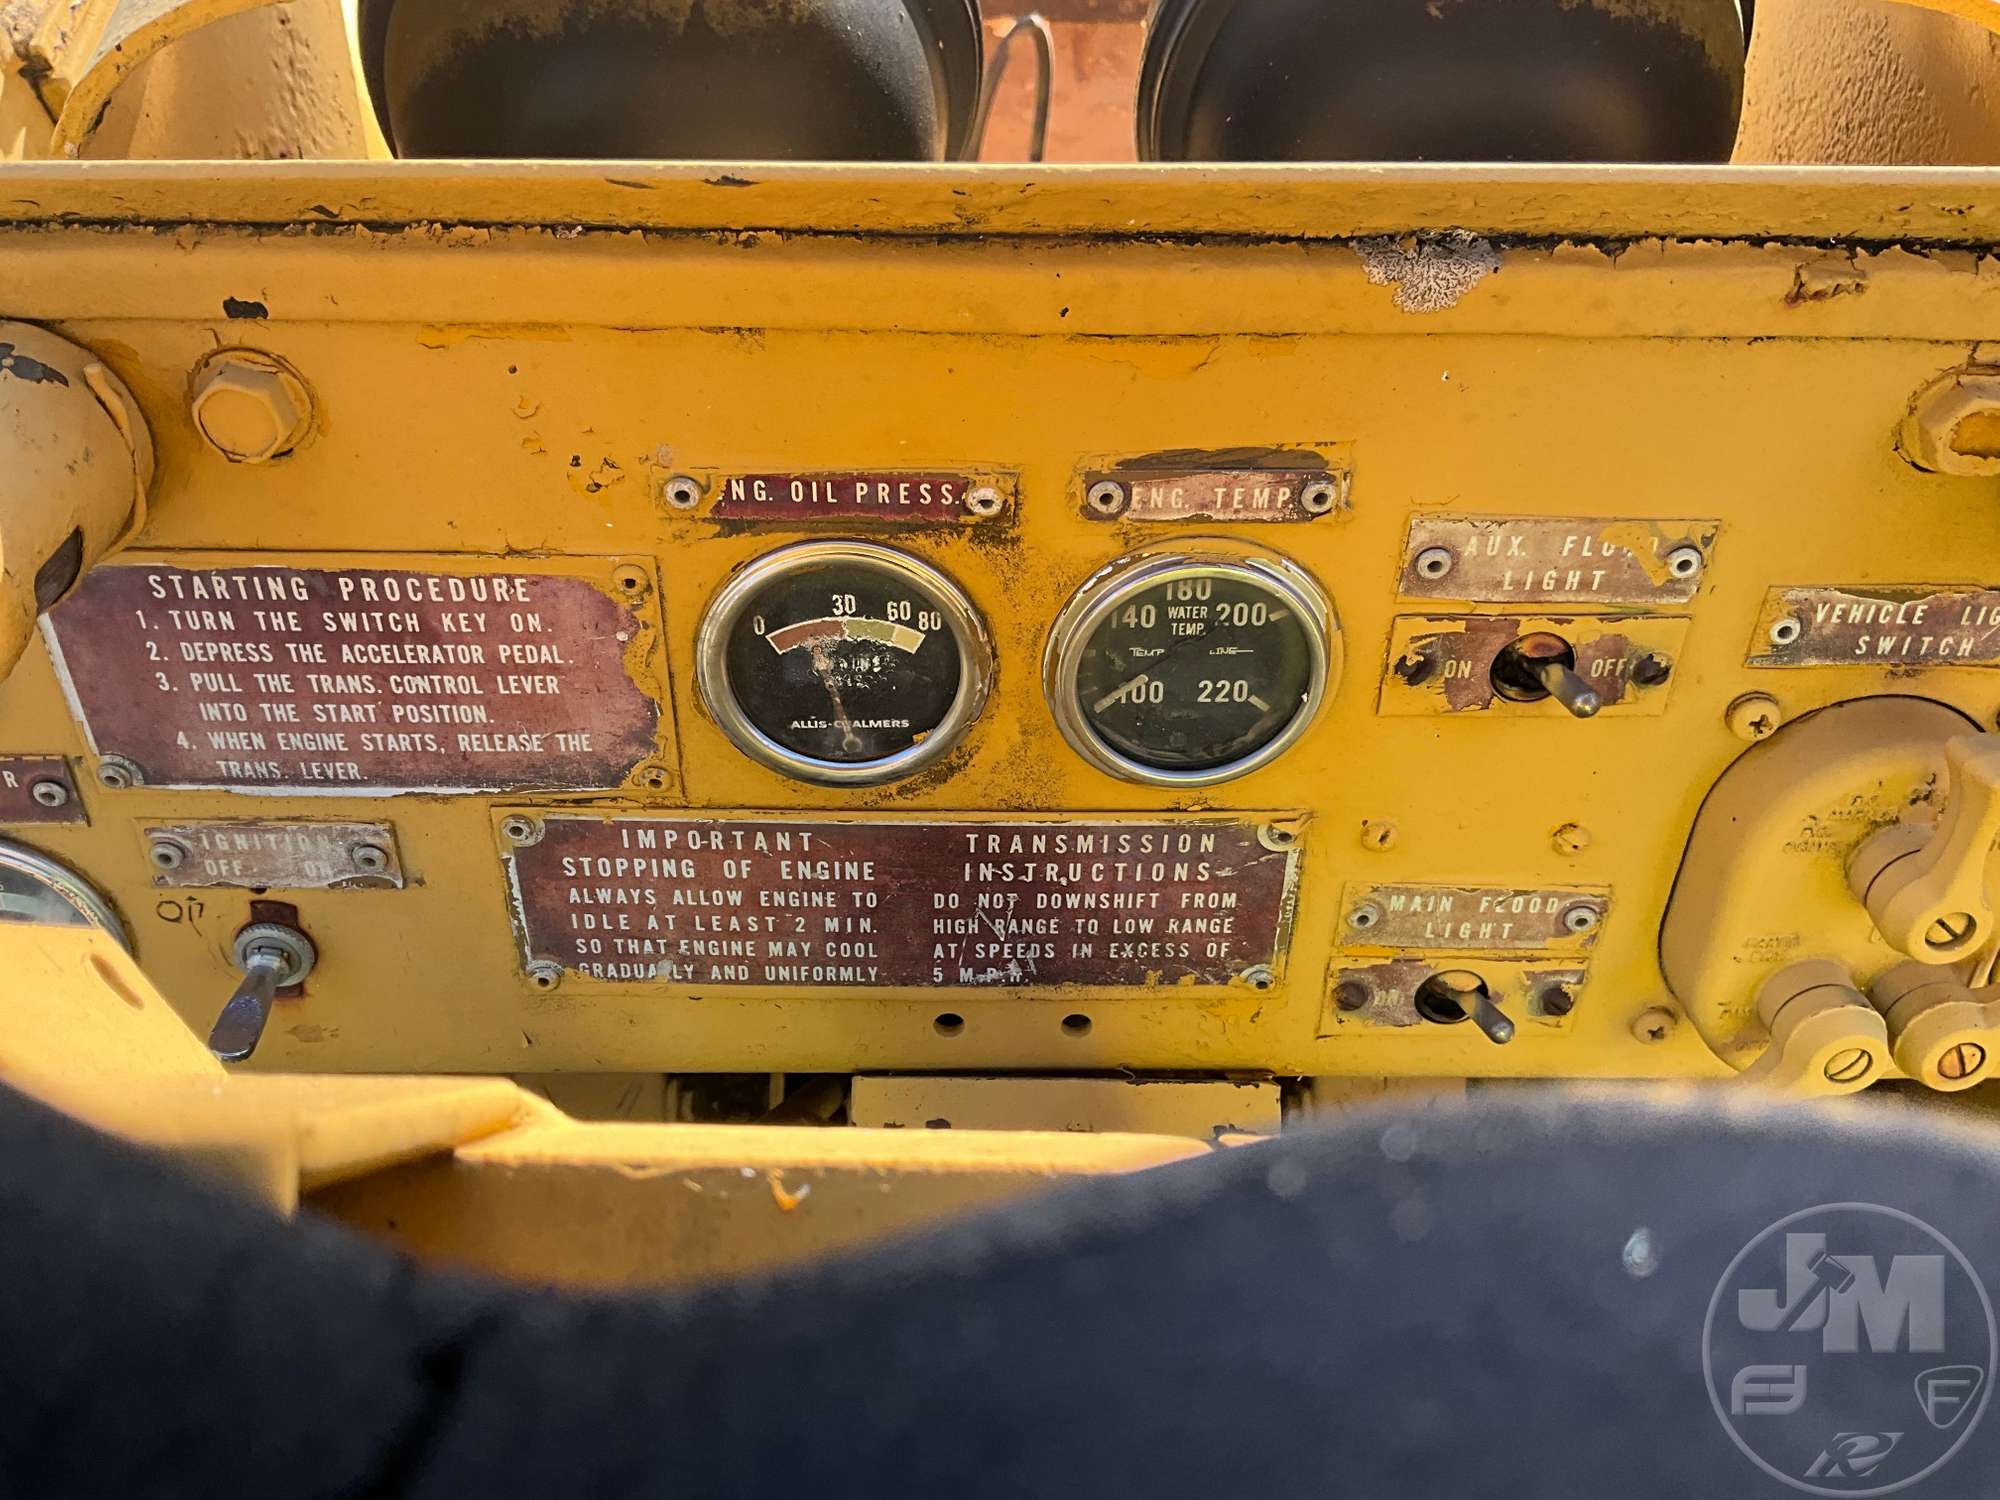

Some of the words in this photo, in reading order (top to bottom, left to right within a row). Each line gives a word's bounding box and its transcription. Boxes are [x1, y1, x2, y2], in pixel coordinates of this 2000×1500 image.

[718, 480, 773, 501] NG.
[791, 482, 837, 503] OIL
[856, 482, 959, 505] PRESS.
[1132, 488, 1189, 508] ENG.
[1214, 488, 1293, 509] TEMP.
[1465, 535, 1526, 557] AUX.
[1562, 535, 1659, 557] FLO
[149, 575, 308, 601] STARTING
[339, 577, 531, 603] PROCEDURE
[1166, 578, 1212, 601] 180
[1503, 570, 1605, 591] LIGHT
[832, 594, 856, 616] 30
[887, 601, 911, 621] 60
[1168, 606, 1208, 620] WATER
[1215, 602, 1267, 627] 200
[1816, 603, 1928, 625] VEHICLE
[136, 610, 159, 630] 1.
[169, 610, 235, 631] TURN
[253, 611, 302, 632] THE
[323, 612, 420, 633] SWITCH
[442, 613, 486, 633] KEY
[510, 613, 553, 633] ON.
[753, 615, 765, 636] 0
[918, 611, 941, 631] 80
[1111, 604, 1156, 628] 140
[1171, 622, 1206, 636] TEMP.
[146, 641, 169, 661] 2.
[180, 642, 274, 663] DEPRESS
[285, 643, 327, 664] THE
[342, 644, 485, 664] ACCELERATOR
[498, 644, 574, 664] PEDAL.
[1855, 635, 1974, 657] SWITCH
[1444, 659, 1472, 679] ON
[1591, 658, 1628, 678] OFF
[155, 672, 179, 691] 3.
[190, 673, 243, 692] PULL
[253, 673, 295, 693] THE
[307, 674, 382, 694] TRANS.
[390, 675, 484, 695] CONTROL
[497, 675, 561, 695] LEVER
[1197, 679, 1249, 703] 220
[199, 702, 248, 722] INTO
[259, 703, 300, 723] THE
[313, 703, 377, 723] START
[392, 704, 495, 724] POSITION.
[791, 718, 910, 729] ALLIS-CALMERS
[176, 731, 197, 750] 4.
[207, 731, 267, 750] WHEN
[277, 732, 349, 752] ENGINE
[360, 733, 446, 755] STARTS,
[457, 733, 545, 752] RELEASE
[555, 734, 593, 752] THE
[216, 760, 290, 779] TRANS.
[300, 762, 369, 780] LEVER.
[199, 833, 332, 851] IGNITION
[621, 828, 813, 851] IMPORTANT
[965, 833, 1216, 854] TRANSMISSION
[204, 858, 243, 877] OFF
[562, 857, 696, 879] STOPPING
[723, 859, 752, 880] OF
[780, 860, 876, 881] ENGINE
[964, 862, 1211, 883] INSTRUCTIONS
[569, 887, 656, 905] ALWAYS
[672, 889, 743, 907] ALLOW
[759, 890, 837, 908] ENGINE
[852, 891, 878, 909] TO
[934, 892, 960, 910] DO
[977, 892, 1019, 911] NOT
[1036, 892, 1160, 910] DOWNSHIFT
[1180, 892, 1238, 909] FROM
[1390, 895, 1453, 914] MAIN
[1479, 896, 1559, 915] FLOOD
[571, 913, 630, 931] IDLE
[647, 914, 676, 931] AT
[695, 915, 776, 933] LEAST
[794, 916, 806, 933] 2
[824, 916, 878, 933] MIN.
[933, 917, 979, 935] HIGH
[994, 917, 1059, 935] RANGE
[1075, 918, 1100, 935] TO
[1112, 917, 1154, 934] LOW
[1167, 917, 1233, 935] RANGE
[1424, 922, 1514, 940] LIGHT
[575, 937, 602, 955] SO
[613, 938, 667, 955] THAT
[679, 939, 756, 957] ENGINE
[768, 940, 811, 957] MAY
[826, 941, 878, 958] COOL
[933, 942, 958, 960] AT
[975, 942, 1055, 959] SPEEDS
[1072, 942, 1092, 959] IN
[1109, 942, 1190, 959] EXCESS
[1206, 942, 1231, 959] OF
[578, 962, 694, 980] GRADUALY
[711, 964, 750, 981] AND
[764, 965, 878, 982] UNIFORMLY
[933, 967, 944, 983] 5
